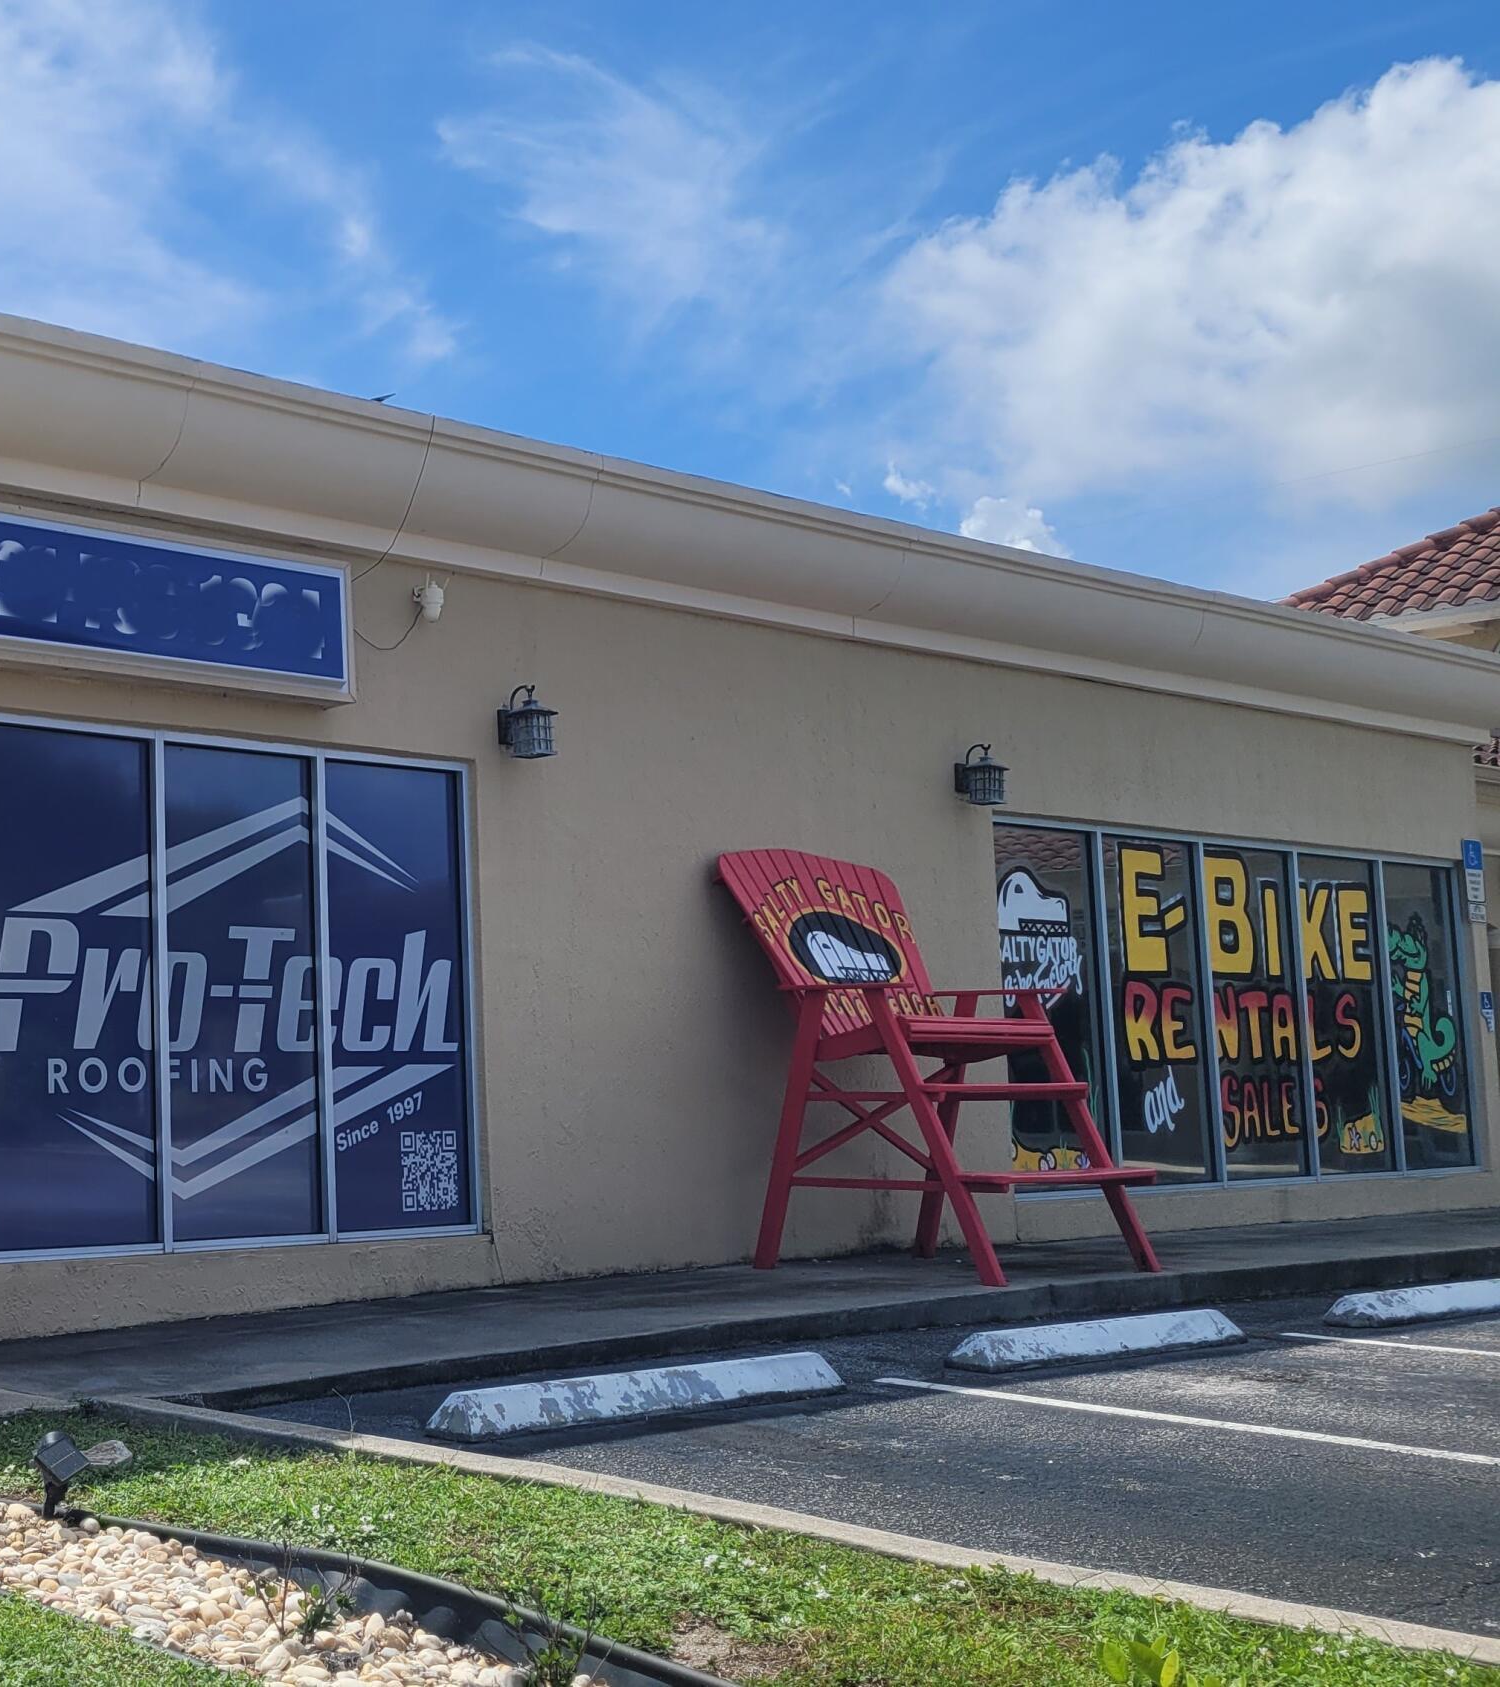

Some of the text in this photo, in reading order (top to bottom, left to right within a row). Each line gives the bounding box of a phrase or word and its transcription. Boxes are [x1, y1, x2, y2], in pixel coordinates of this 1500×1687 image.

[753, 876, 917, 944] SALTY GATOR
[1119, 846, 1373, 981] E-BIKE
[999, 936, 1078, 963] ALTYGATOR
[824, 991, 944, 1023] COA EACH
[1123, 980, 1363, 1061] RENTALS
[336, 1091, 424, 1152] Since 1997
[1144, 1065, 1185, 1134] and
[1220, 1074, 1329, 1148] SALES
